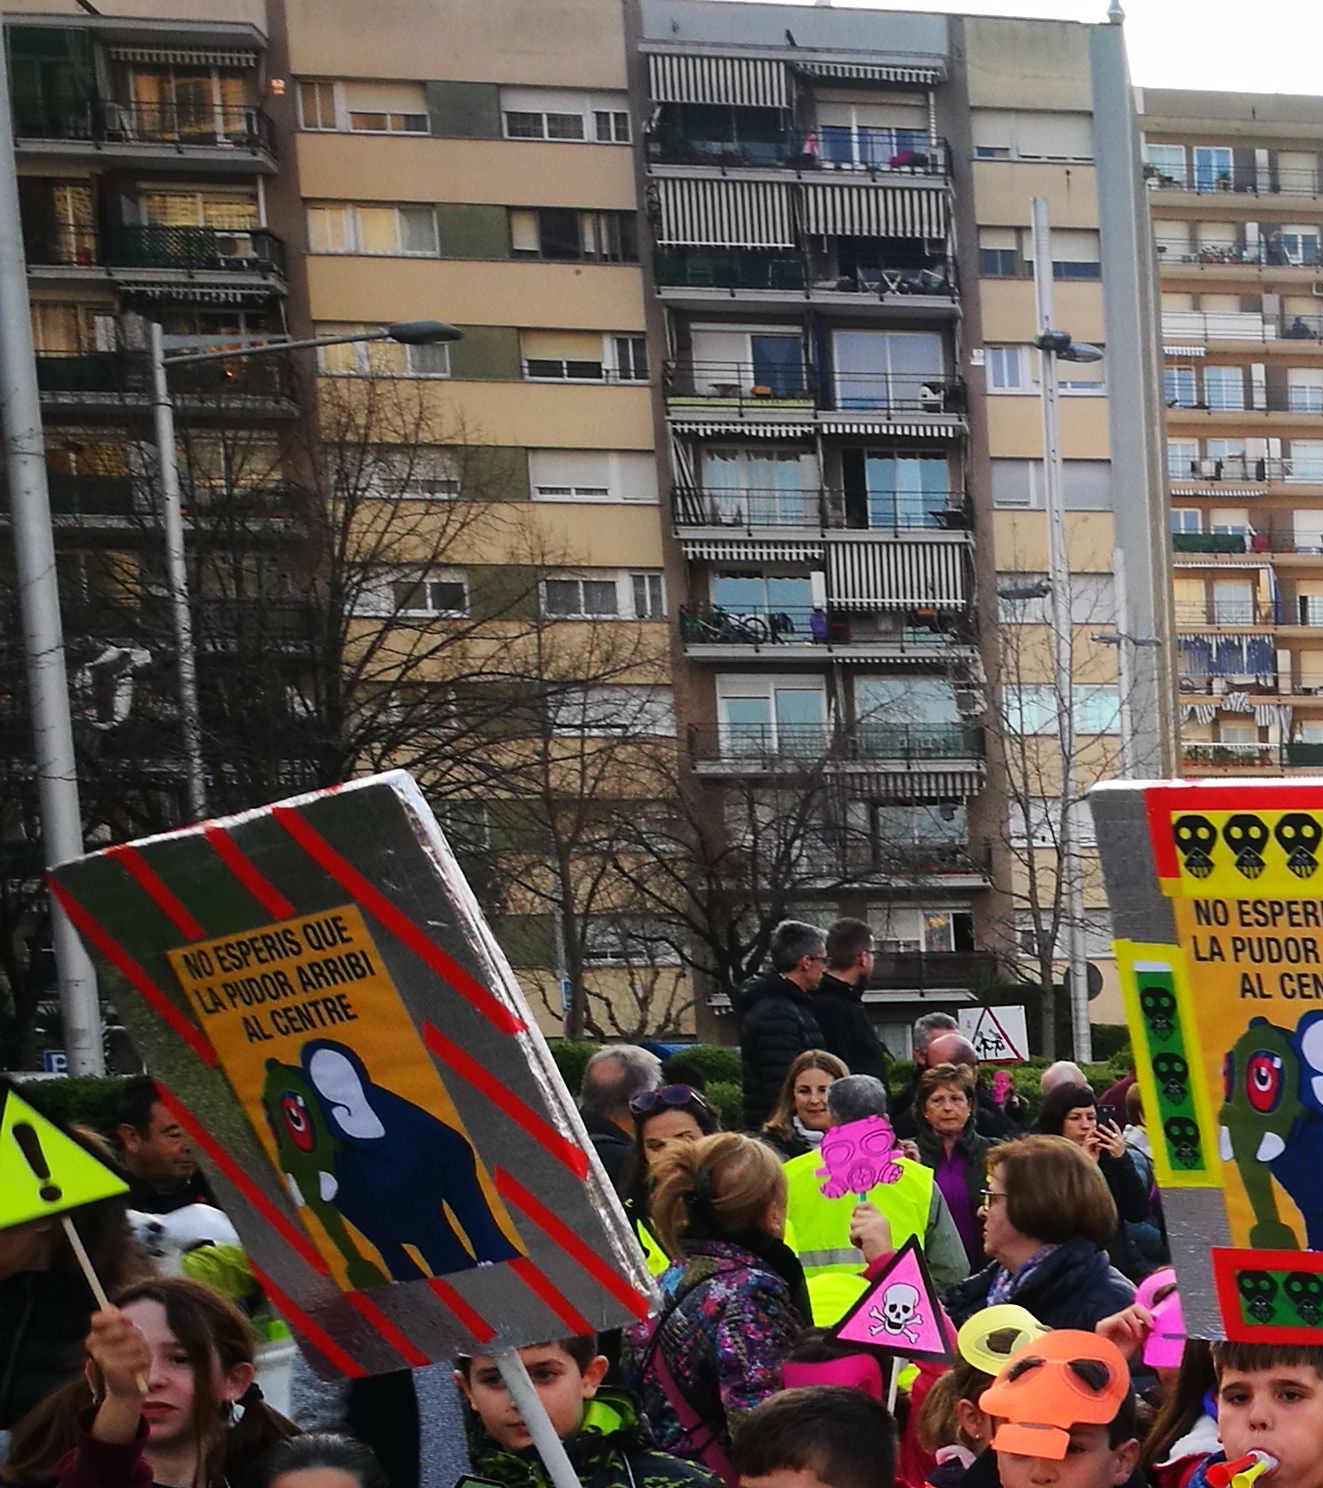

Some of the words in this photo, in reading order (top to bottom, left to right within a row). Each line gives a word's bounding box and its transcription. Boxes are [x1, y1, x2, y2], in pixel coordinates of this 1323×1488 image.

[1194, 899, 1229, 928] NO
[182, 951, 213, 979] NO
[217, 929, 302, 974] ESPERIS
[303, 915, 354, 952] QUE
[1194, 935, 1224, 963] LA
[1233, 936, 1320, 964] PUDOR
[195, 988, 224, 1016] LA
[224, 967, 296, 1007] PUDOR
[297, 950, 376, 992] ARRIBI
[1239, 972, 1272, 999] AL
[242, 1017, 270, 1044] AL
[272, 992, 359, 1038] CENTRE
